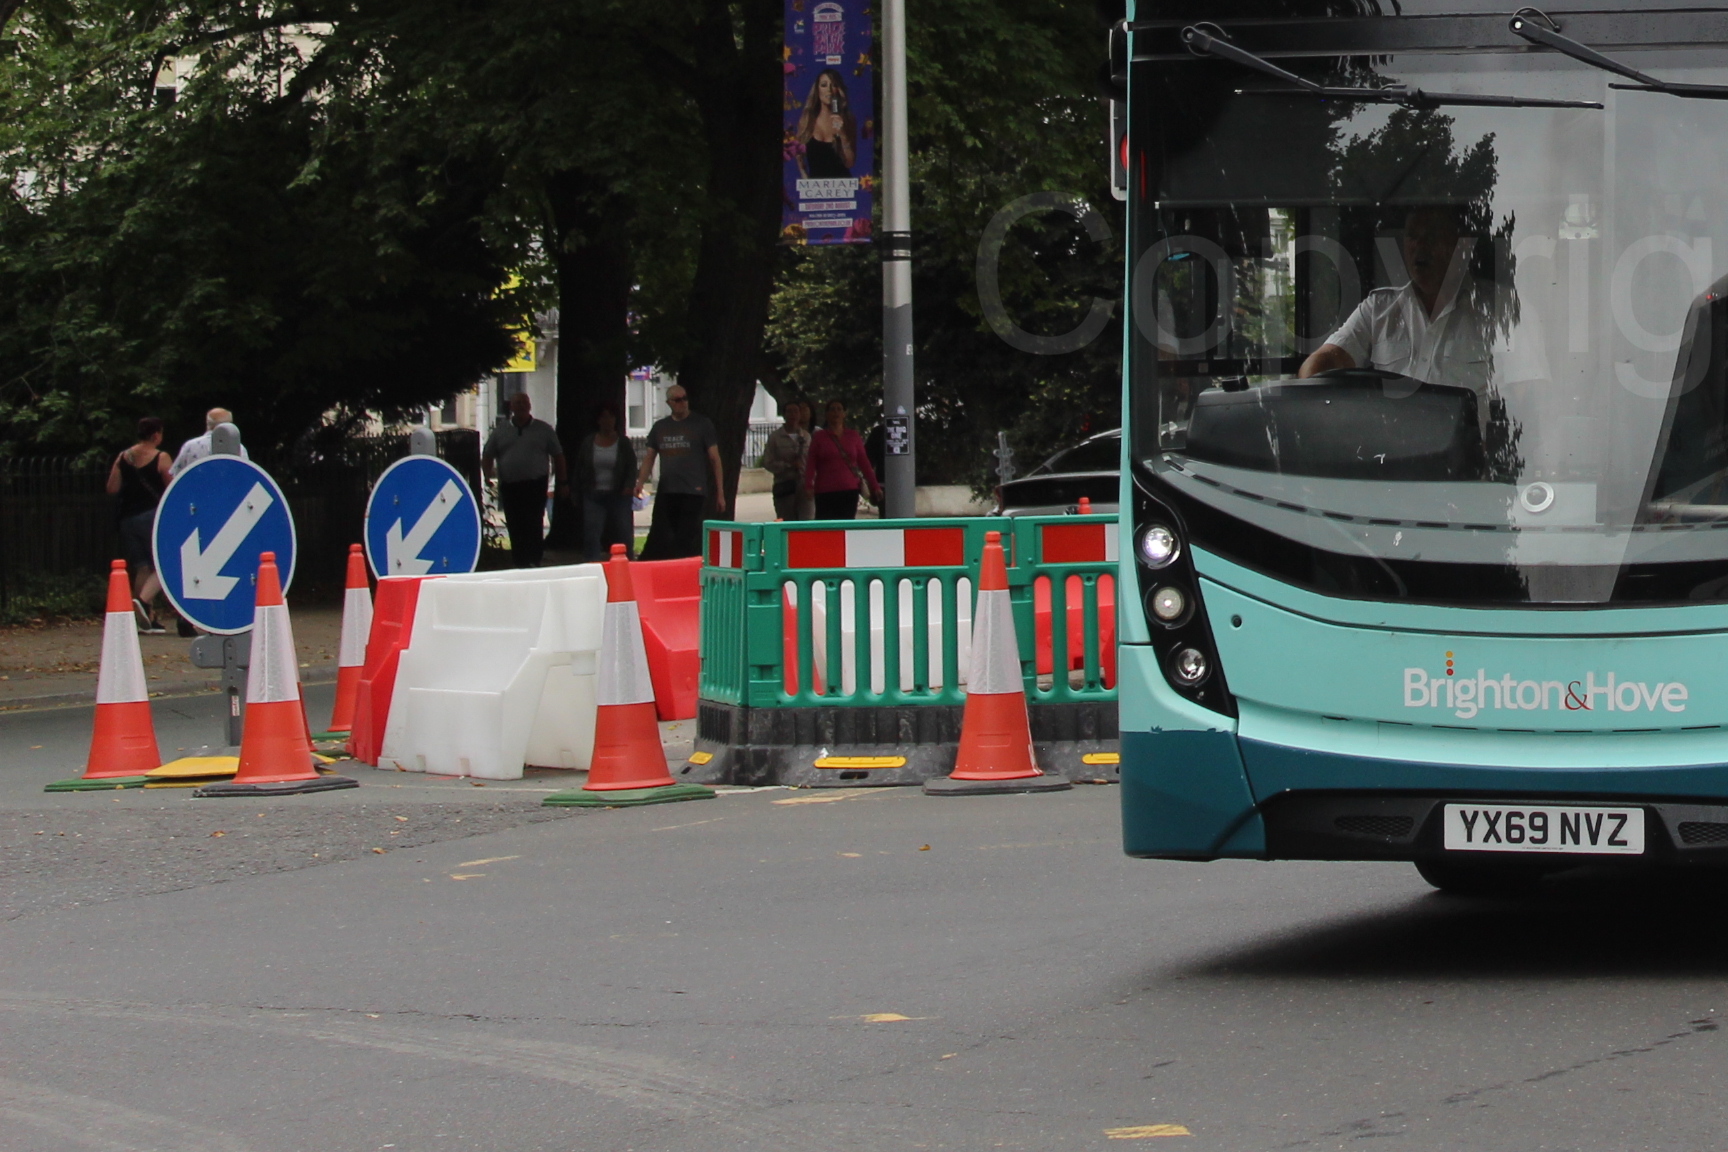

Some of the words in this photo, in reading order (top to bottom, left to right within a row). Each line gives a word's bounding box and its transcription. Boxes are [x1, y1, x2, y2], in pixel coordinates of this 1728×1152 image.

[799, 179, 858, 189] MARIAH
[804, 189, 851, 198] CAREY
[1460, 809, 1549, 845] YX69
[1560, 812, 1628, 847] NVZ
